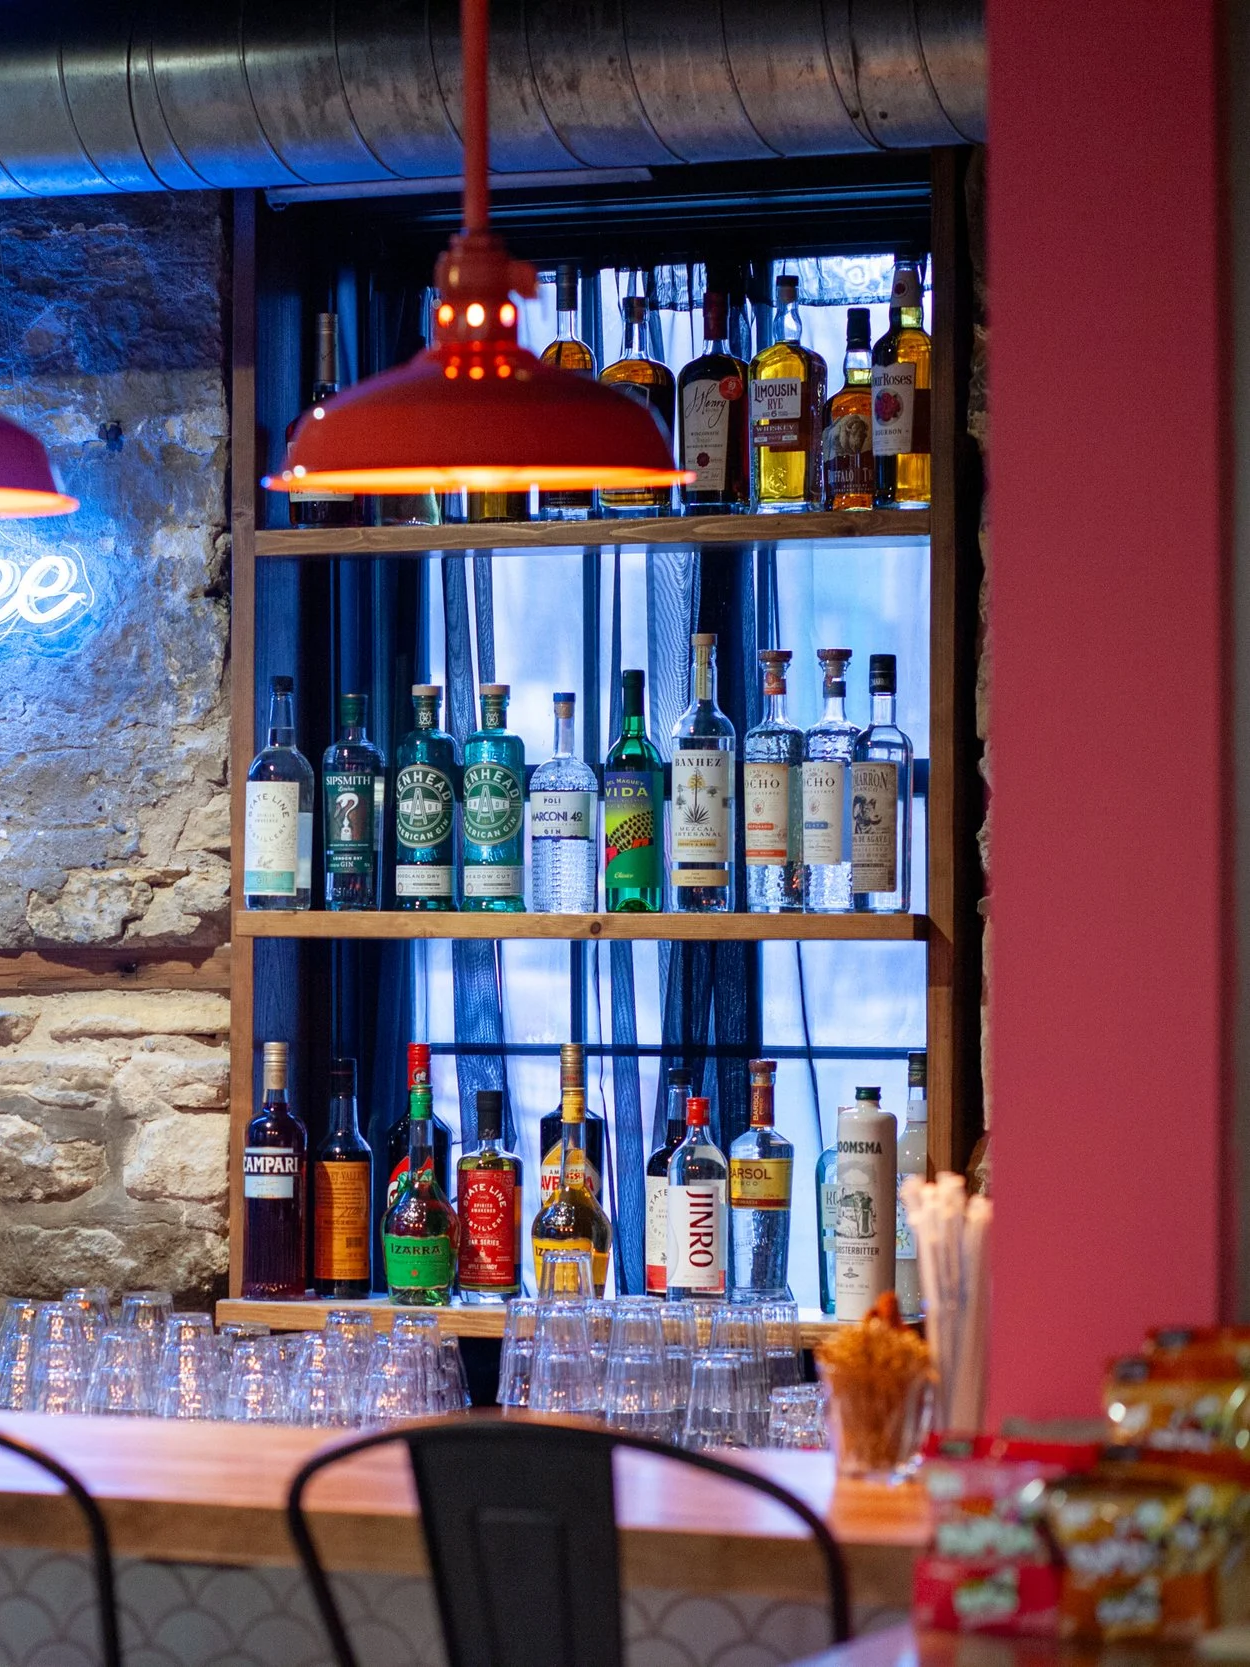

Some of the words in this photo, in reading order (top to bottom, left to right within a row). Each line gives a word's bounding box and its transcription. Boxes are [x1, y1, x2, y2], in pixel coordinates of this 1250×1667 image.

[884, 373, 912, 387] Roses
[752, 381, 798, 403] LIMOUSIN
[767, 398, 784, 410] RYE
[674, 757, 723, 768] BANHEZ
[325, 775, 371, 786] SIPSMITH
[803, 777, 835, 787] CHO
[605, 787, 649, 798] VIDA
[570, 810, 583, 822] 42
[837, 1140, 883, 1155] OOMSMA
[488, 1185, 507, 1209] LINE
[686, 1190, 714, 1268] JINRO
[390, 1242, 442, 1256] IZARRA
